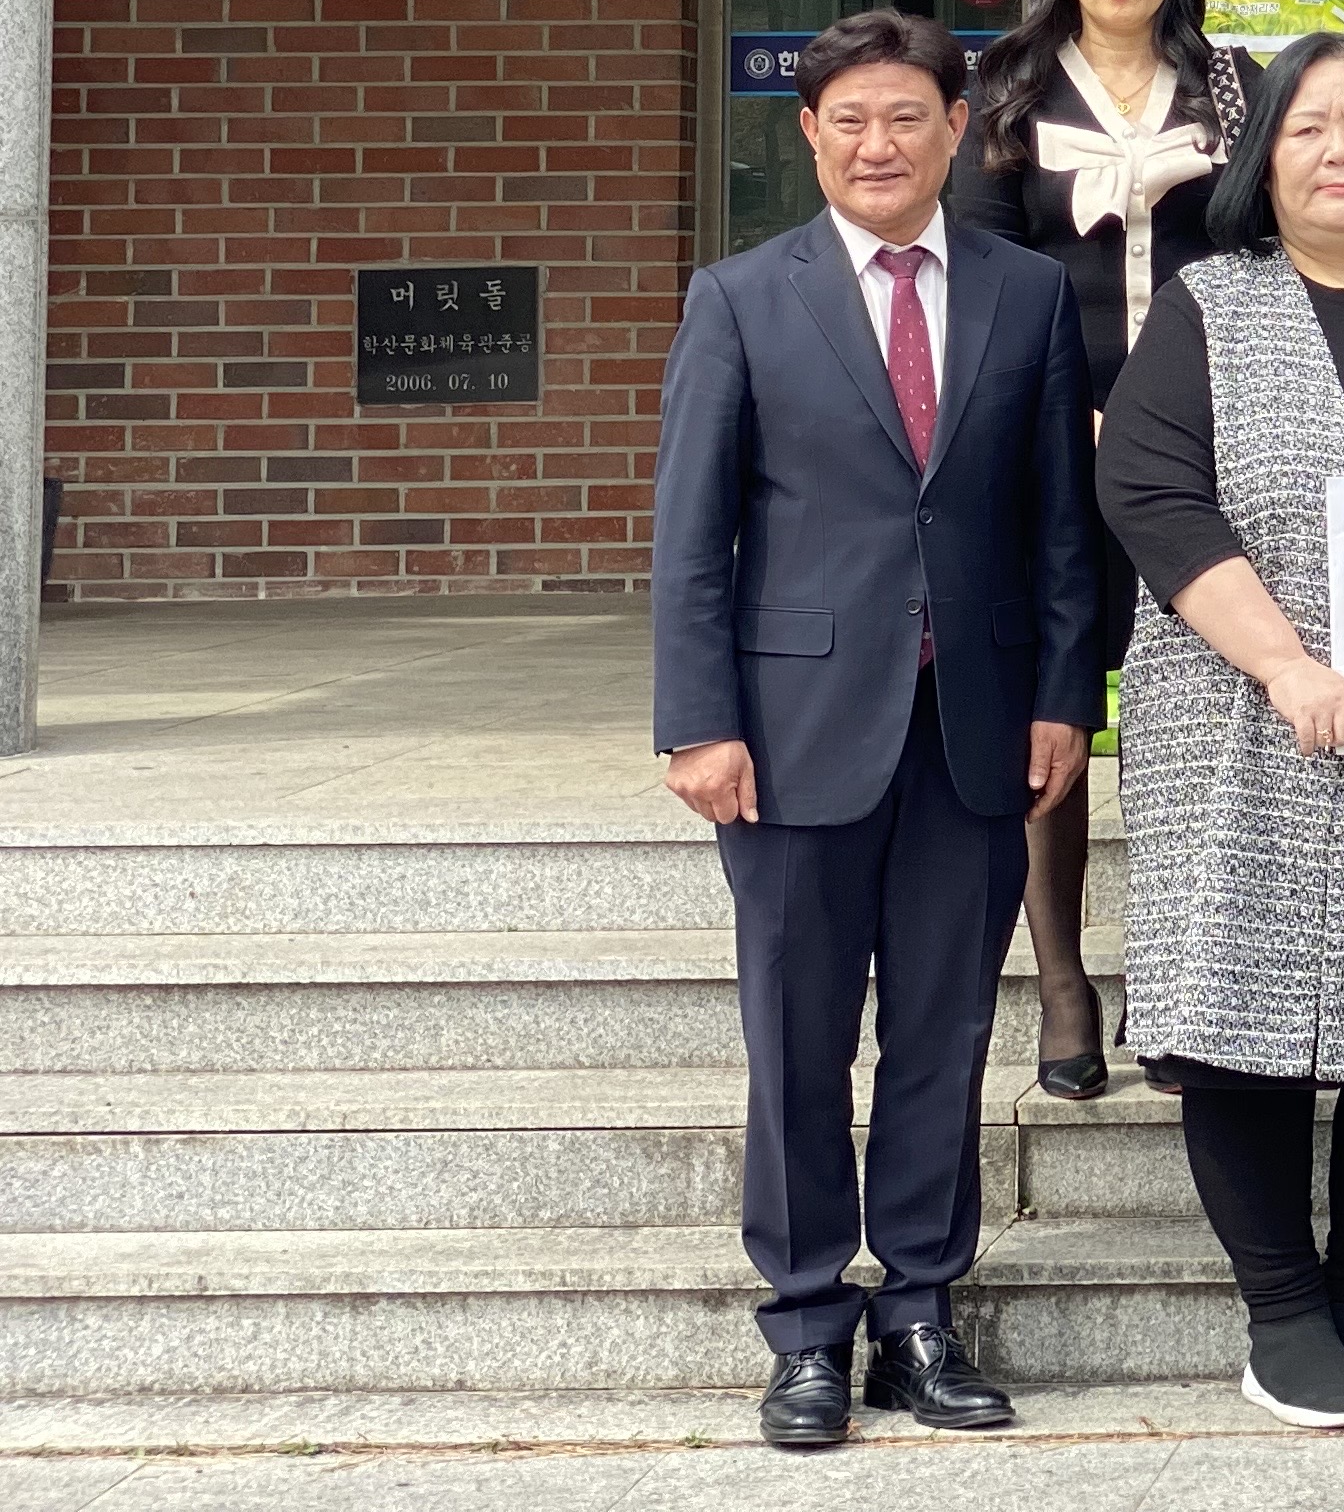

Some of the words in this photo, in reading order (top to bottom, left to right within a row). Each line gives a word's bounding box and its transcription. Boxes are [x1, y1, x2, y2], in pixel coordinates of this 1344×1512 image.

[386, 374, 437, 392] 2006.
[449, 374, 476, 390] 07.
[488, 373, 509, 390] 10
